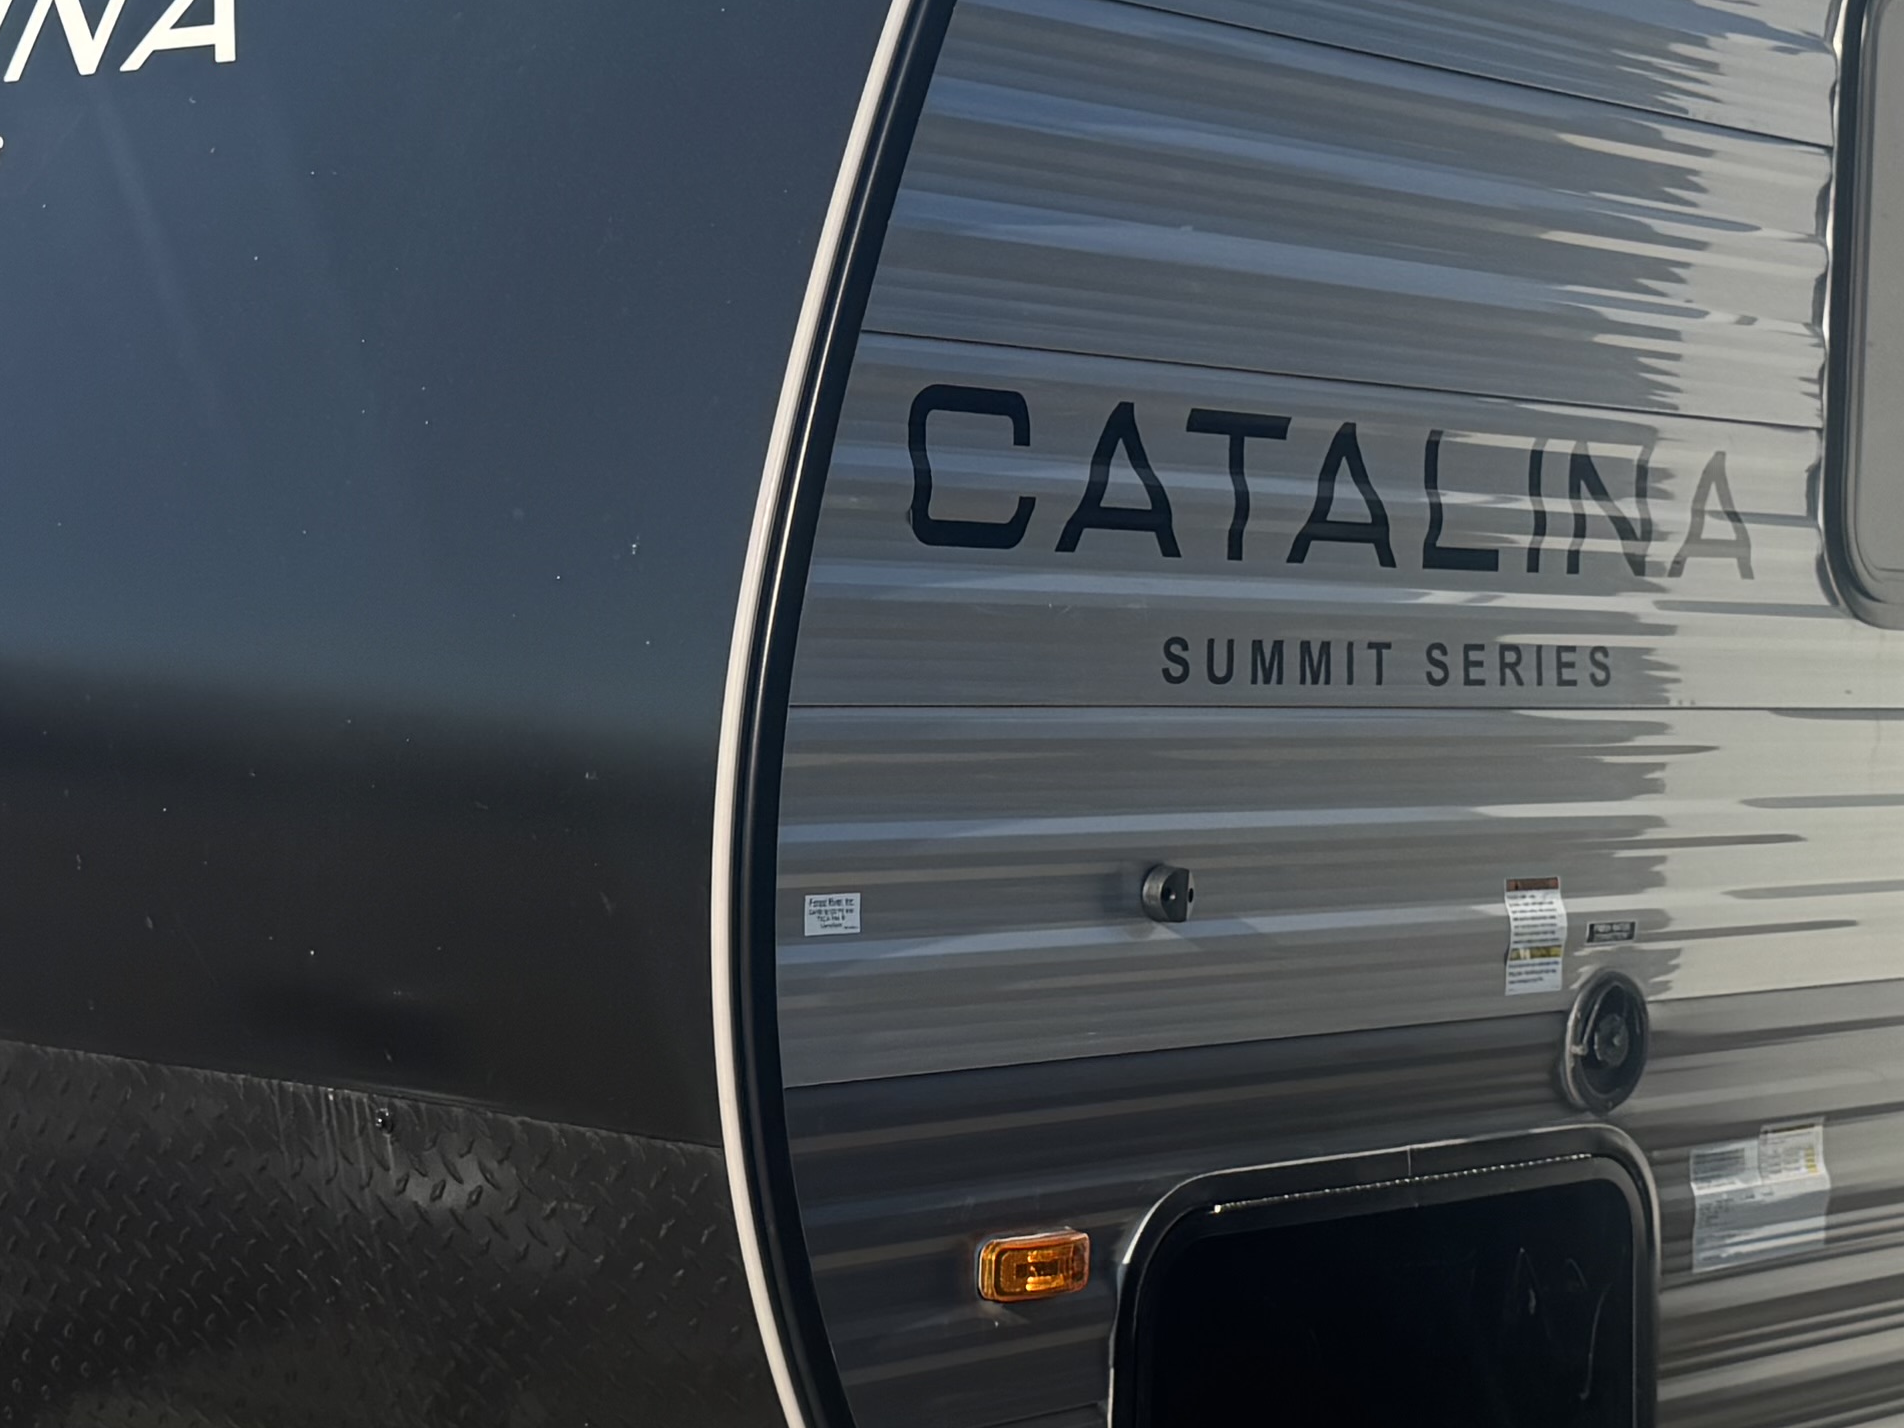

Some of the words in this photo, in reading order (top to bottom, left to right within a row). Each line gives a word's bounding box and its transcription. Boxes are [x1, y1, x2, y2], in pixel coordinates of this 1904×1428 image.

[907, 383, 1756, 581] CATALINA
[1161, 635, 1393, 686] SUMMIT
[1424, 641, 1612, 688] SERIES
